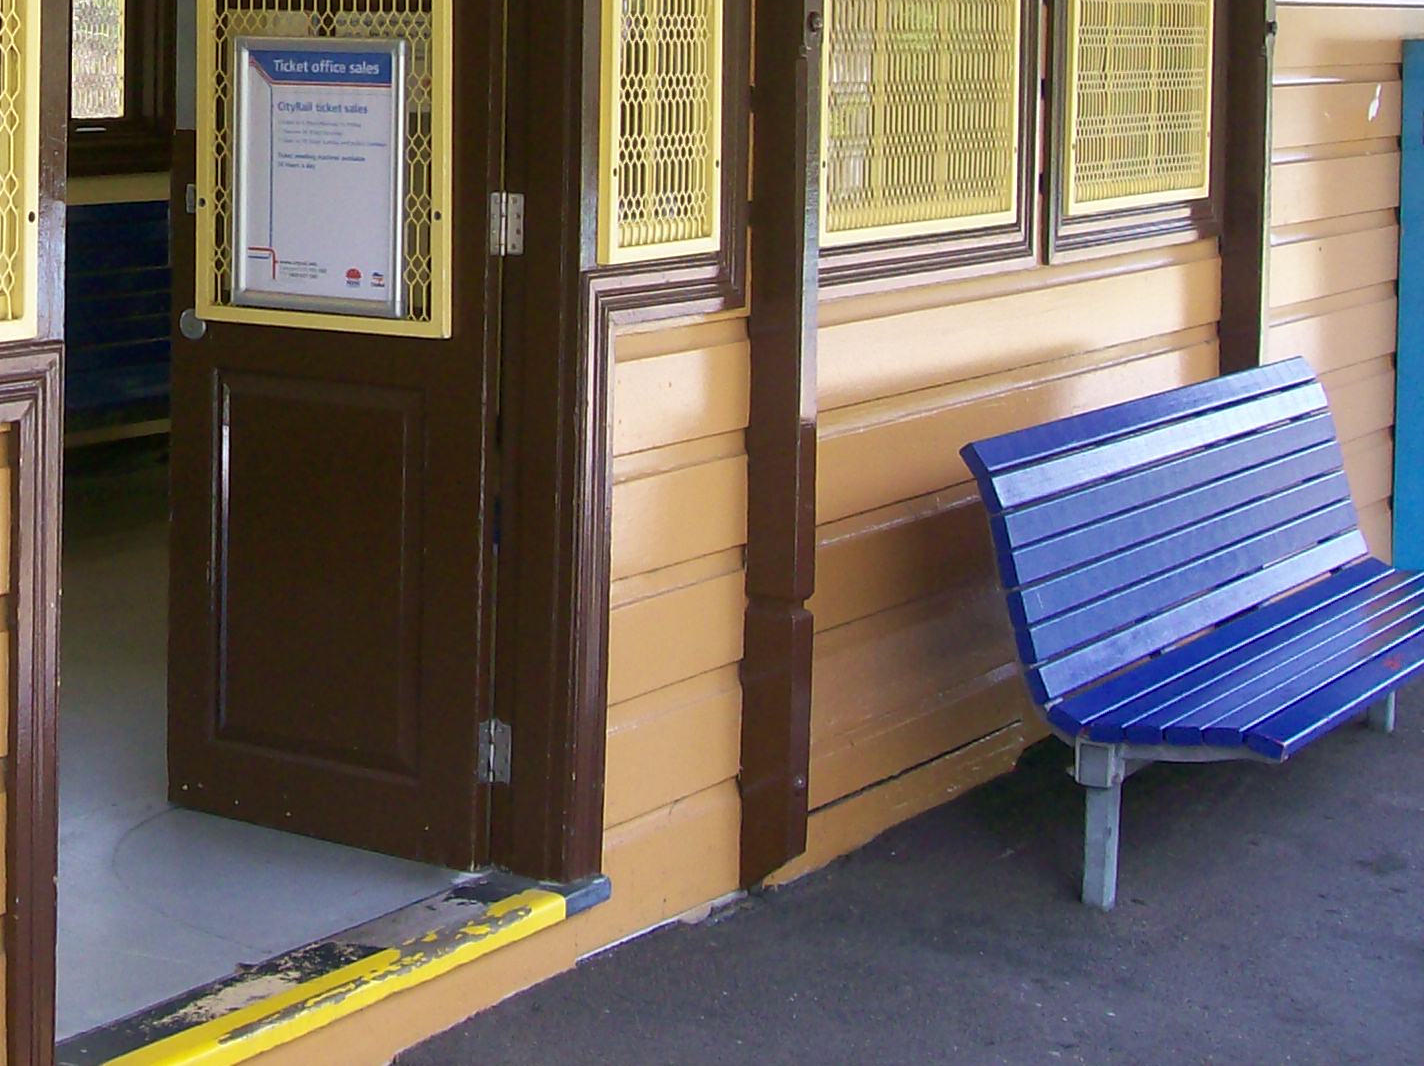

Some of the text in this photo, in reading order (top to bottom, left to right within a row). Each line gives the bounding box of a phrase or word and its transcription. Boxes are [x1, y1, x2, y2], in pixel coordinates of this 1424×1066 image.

[273, 58, 380, 75] Ticket office sales
[277, 101, 368, 114] CityRail ticket sales
